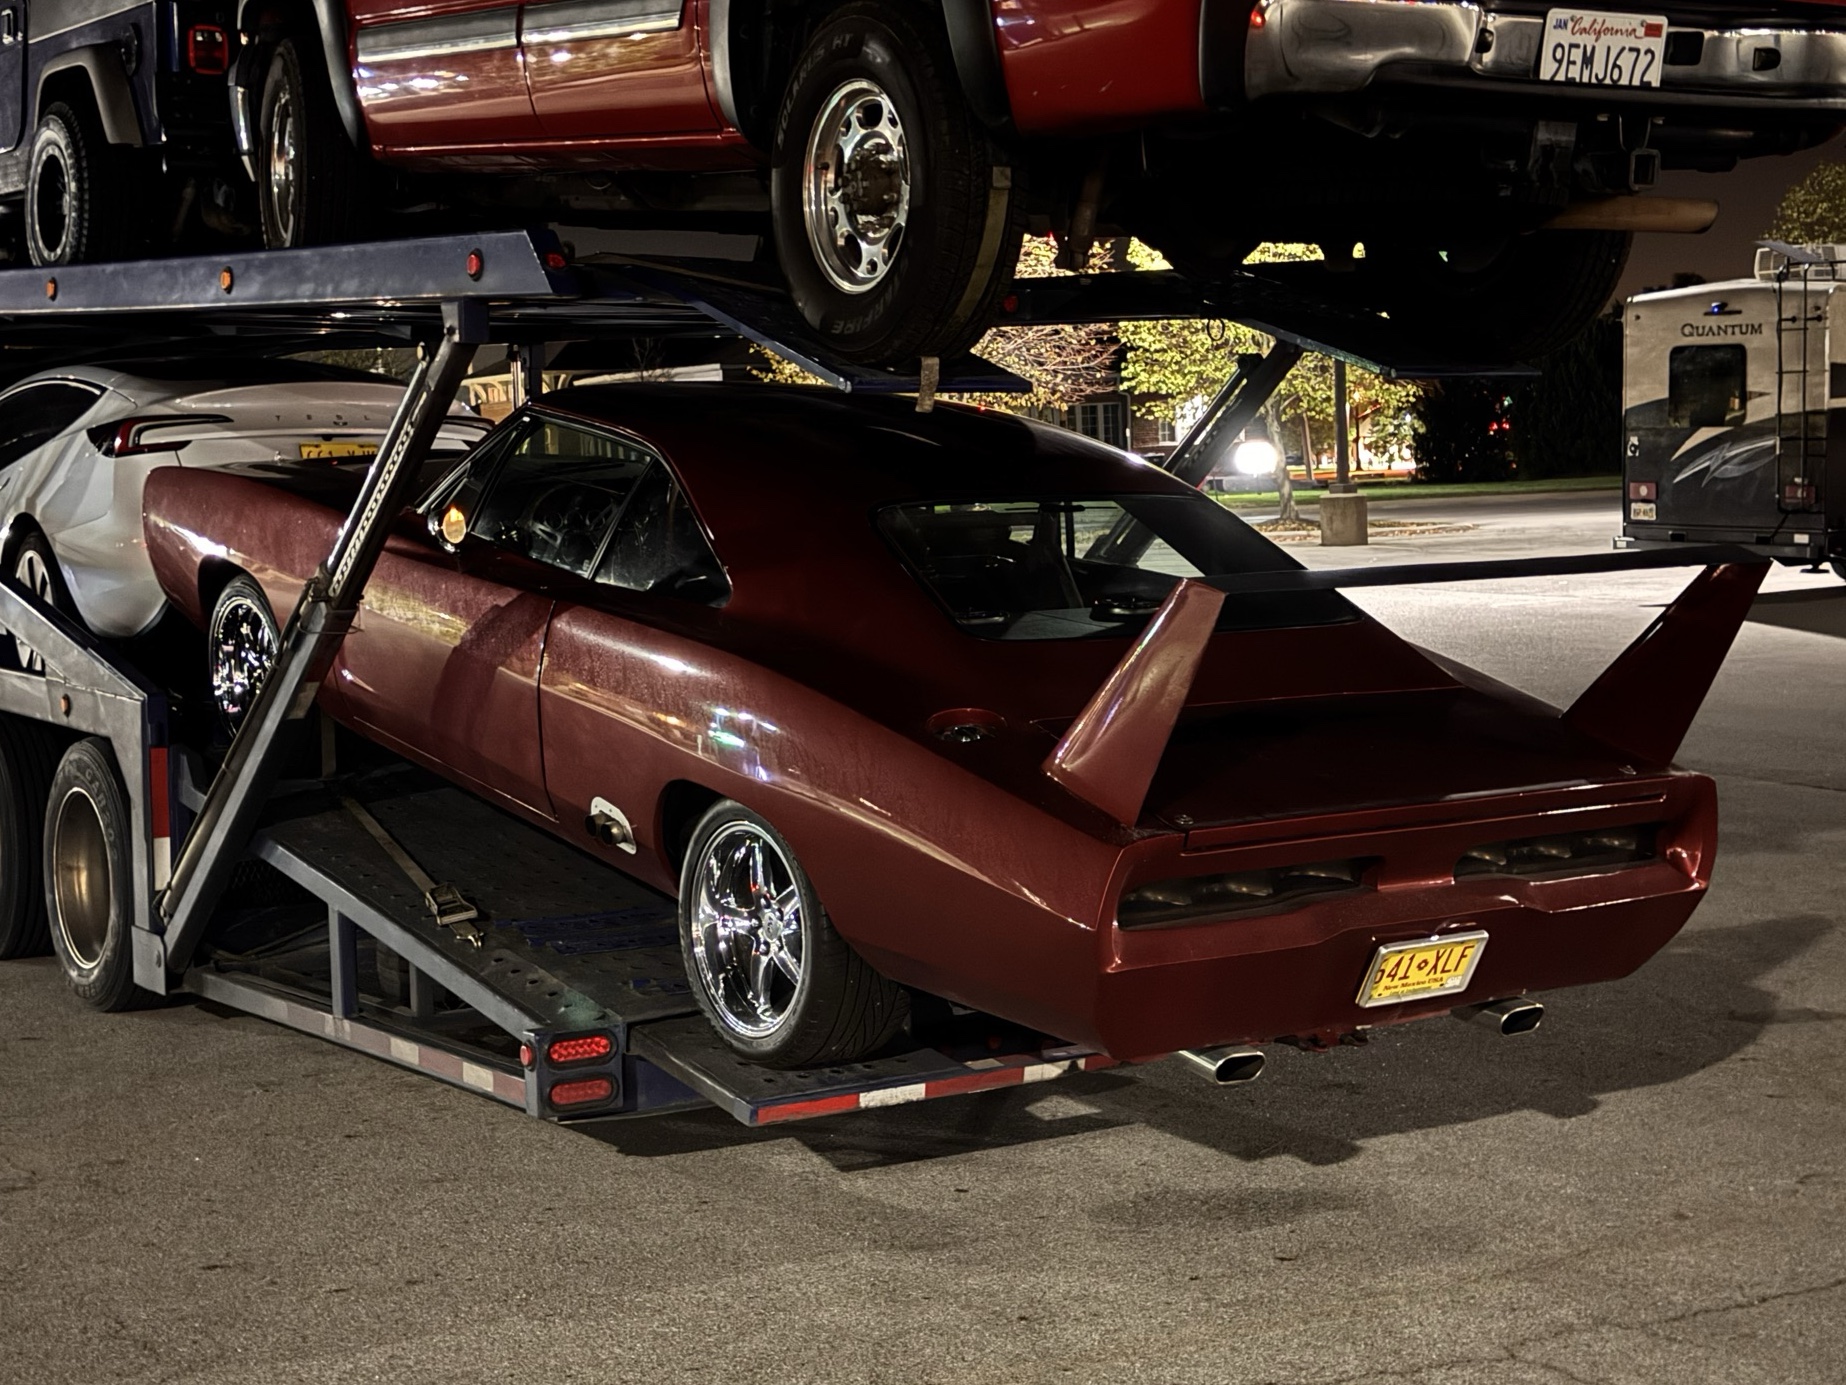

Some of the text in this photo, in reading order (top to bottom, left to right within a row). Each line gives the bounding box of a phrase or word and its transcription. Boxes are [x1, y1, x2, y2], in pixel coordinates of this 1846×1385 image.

[1553, 18, 1569, 30] JAN
[1571, 16, 1645, 42] California
[1550, 42, 1656, 87] 9EMJ672
[1681, 323, 1763, 337] QUANTUM
[1401, 980, 1427, 988] Mexico
